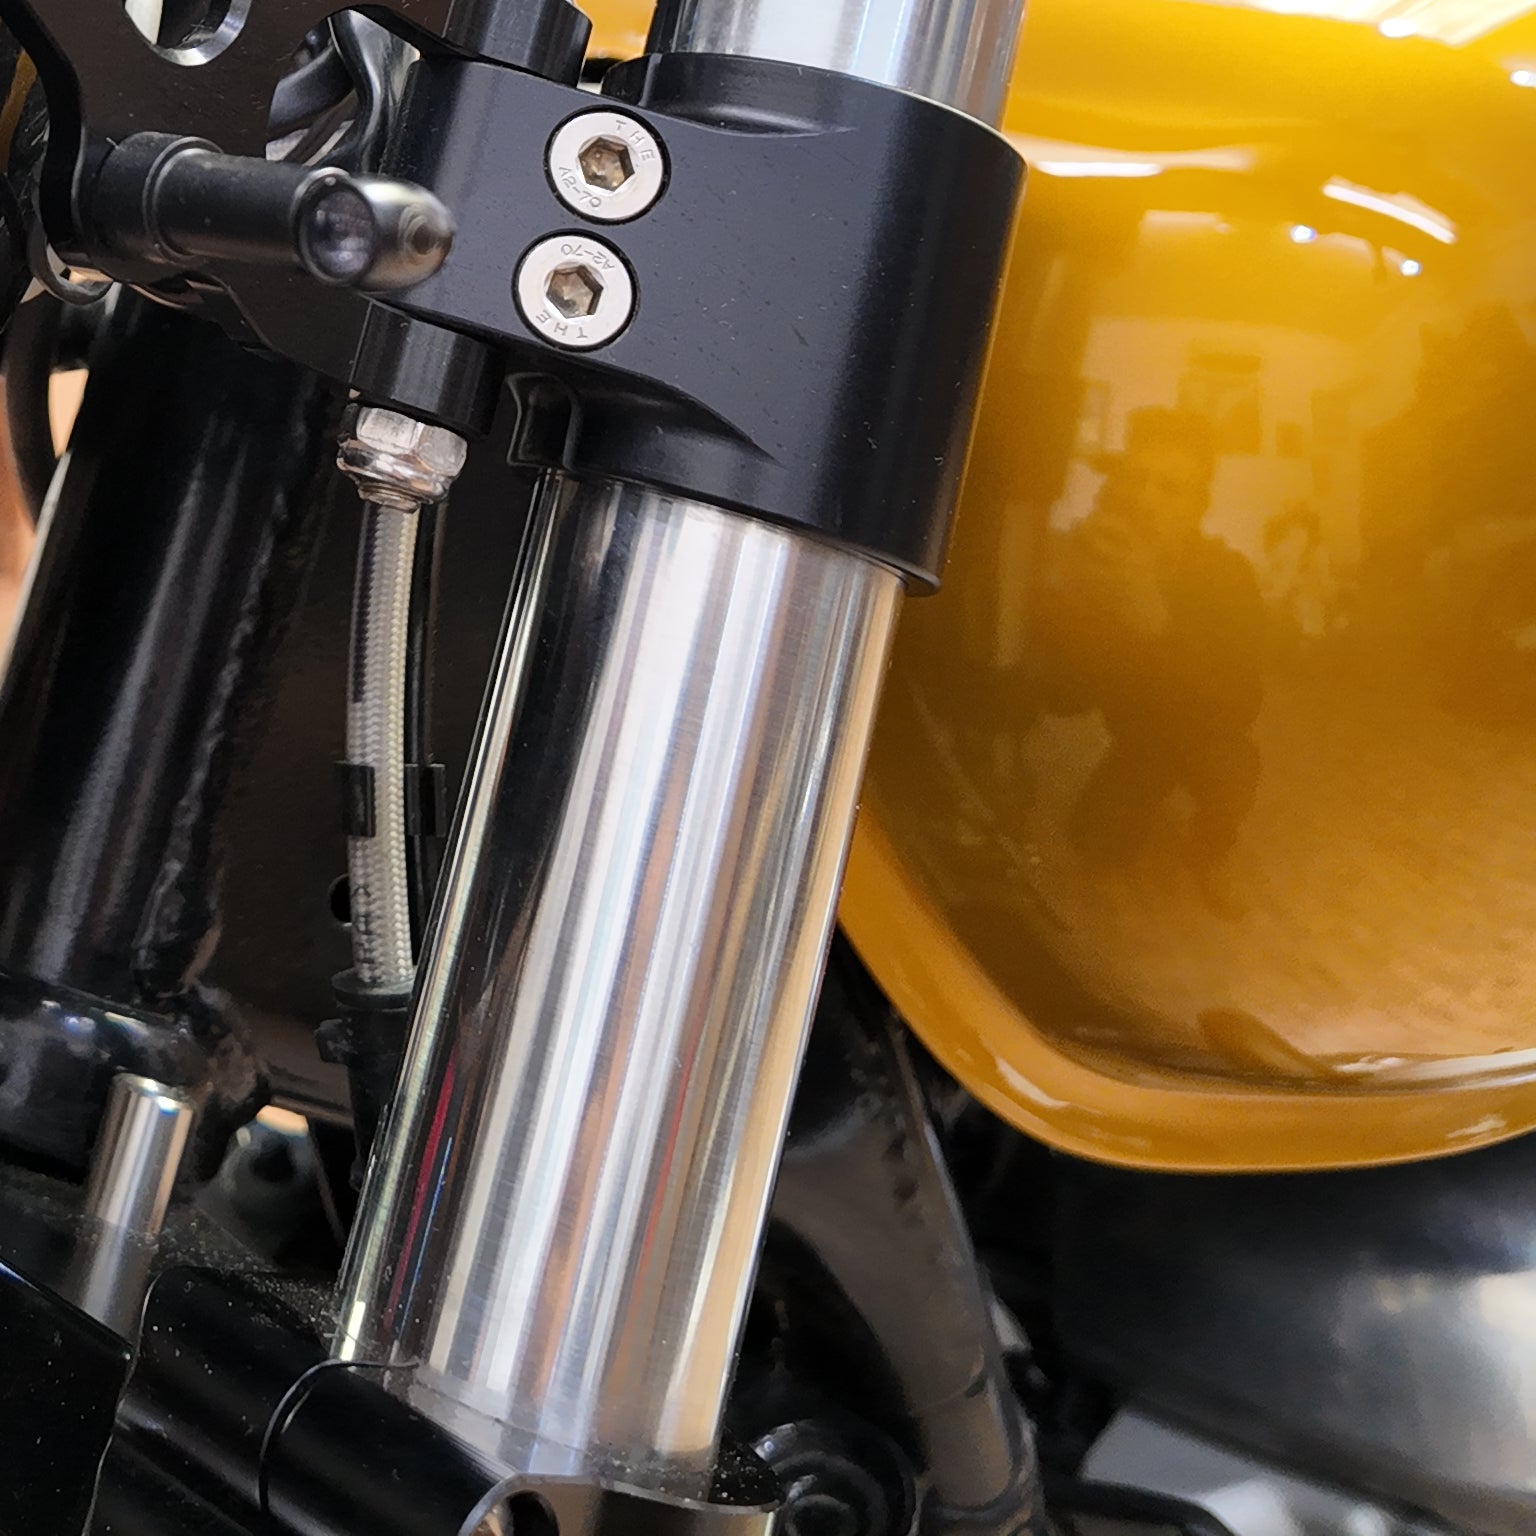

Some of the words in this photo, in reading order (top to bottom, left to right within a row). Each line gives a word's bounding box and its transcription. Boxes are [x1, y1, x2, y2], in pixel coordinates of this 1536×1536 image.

[615, 119, 655, 161] THE
[560, 243, 616, 270] A2-70
[535, 309, 588, 339] THE
